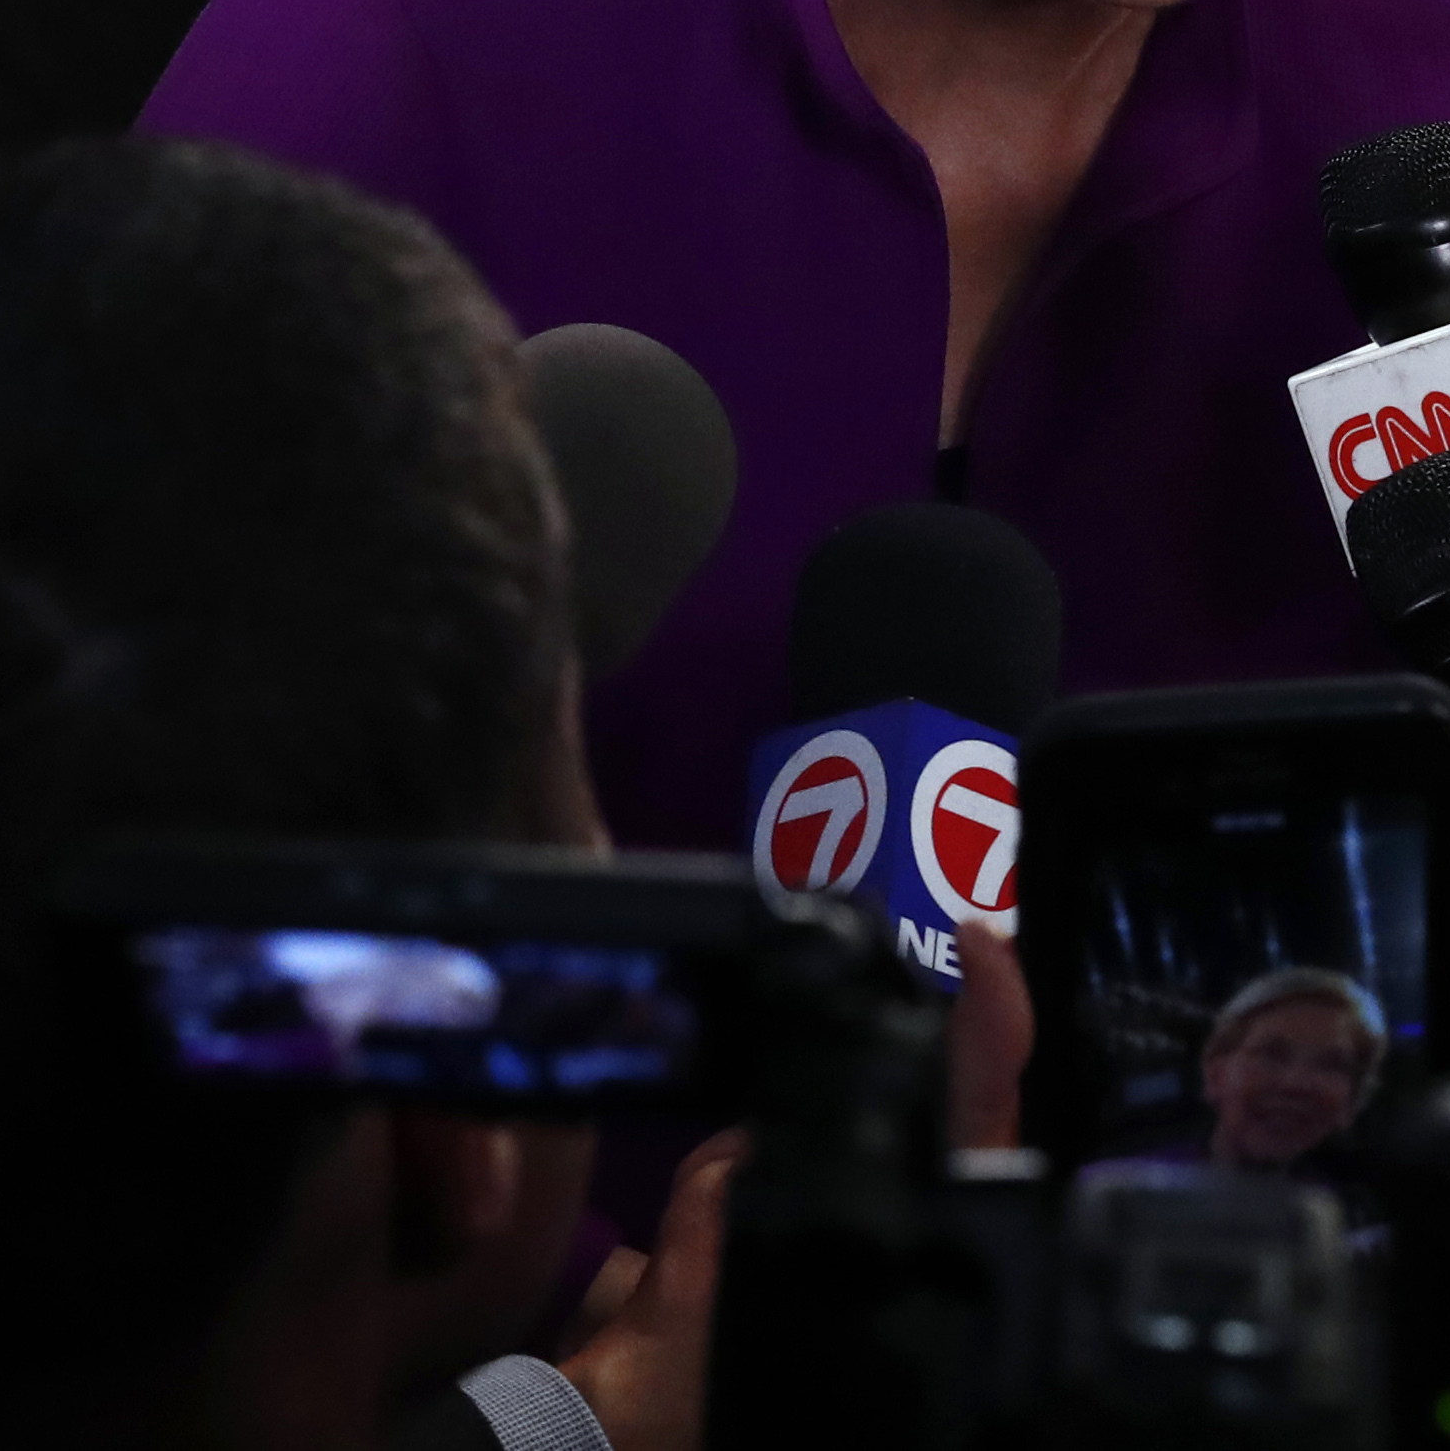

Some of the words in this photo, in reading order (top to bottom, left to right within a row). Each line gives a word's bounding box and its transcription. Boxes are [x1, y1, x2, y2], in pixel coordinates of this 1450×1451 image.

[778, 774, 867, 891] 7
[938, 782, 1023, 907] 7
[897, 915, 965, 980] NE
